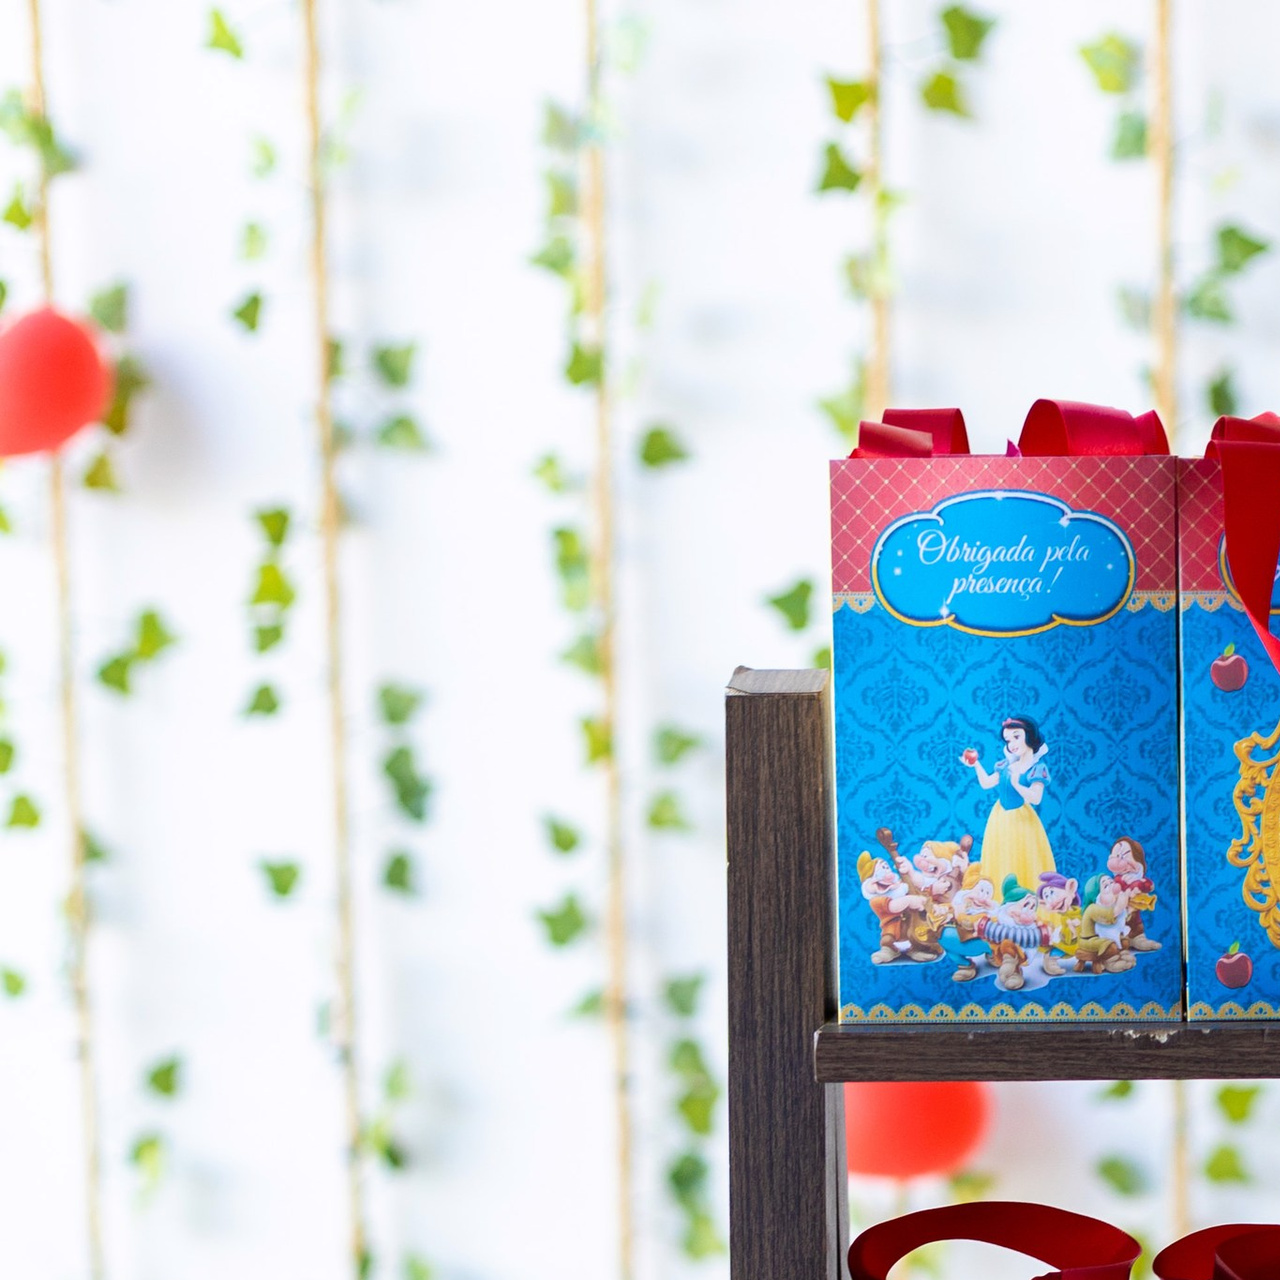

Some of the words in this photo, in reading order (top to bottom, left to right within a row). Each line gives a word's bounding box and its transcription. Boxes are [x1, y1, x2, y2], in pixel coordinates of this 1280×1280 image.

[917, 528, 1037, 575] Obrigada
[1039, 535, 1092, 573] pela
[945, 566, 1064, 604] presença!
